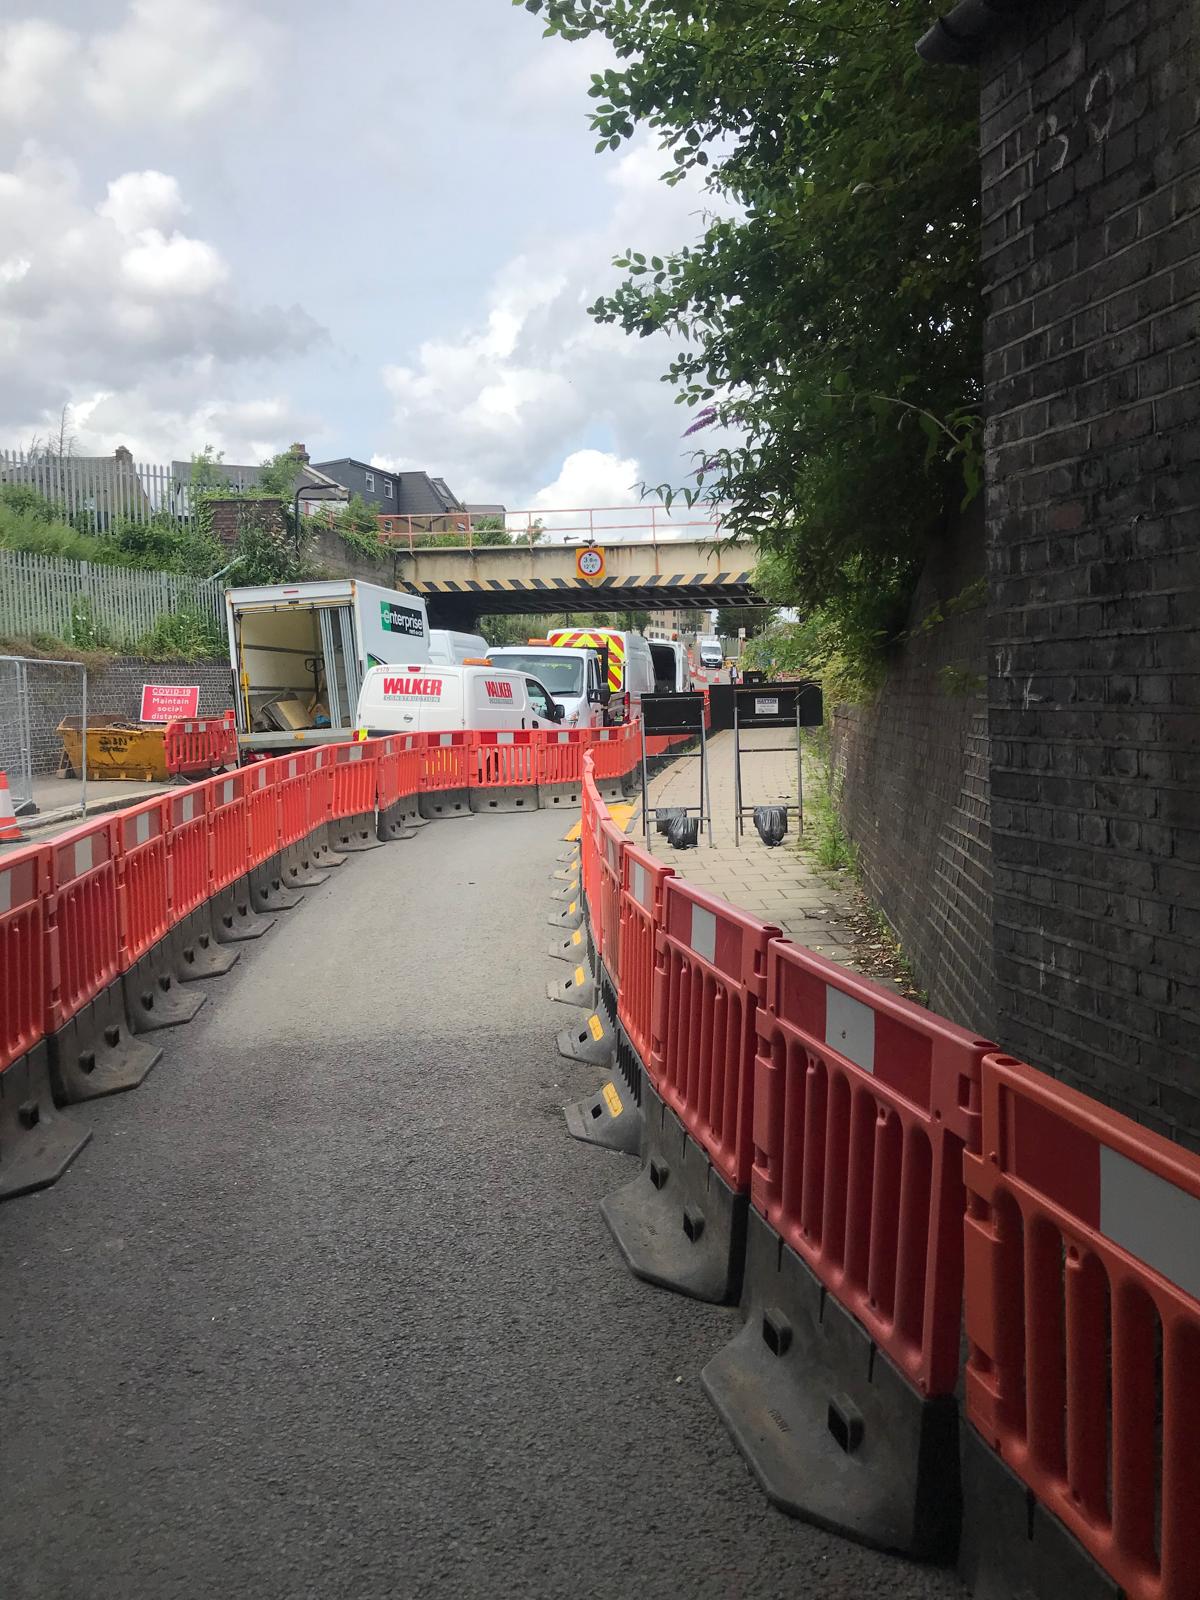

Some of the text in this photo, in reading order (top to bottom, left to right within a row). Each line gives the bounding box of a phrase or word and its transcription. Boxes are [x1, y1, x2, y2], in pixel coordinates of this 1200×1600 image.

[382, 610, 423, 631] enterprise
[152, 687, 191, 696] COVID-19
[383, 677, 443, 696] WALKER
[484, 680, 513, 699] WALKER
[152, 697, 189, 705] Maintain
